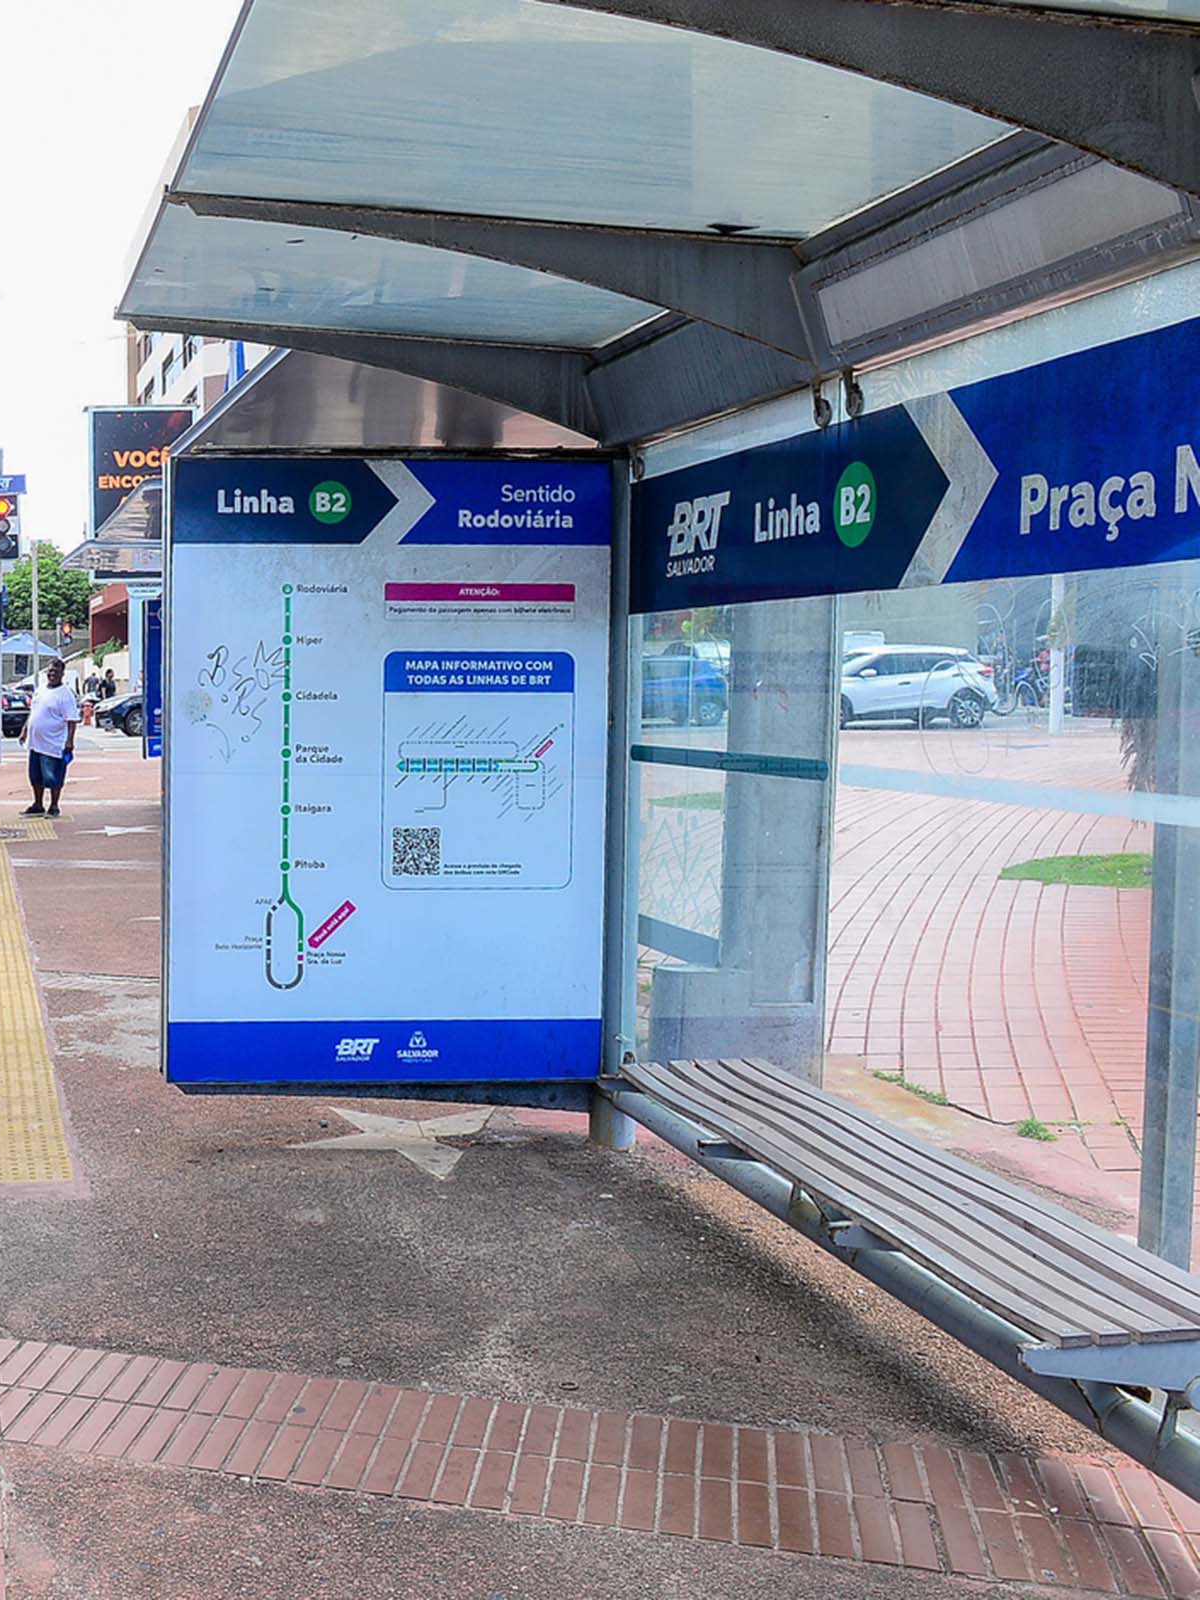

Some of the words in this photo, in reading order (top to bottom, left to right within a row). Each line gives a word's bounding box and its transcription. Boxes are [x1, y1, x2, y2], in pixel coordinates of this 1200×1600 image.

[500, 484, 576, 503] Sentido
[216, 489, 295, 514] Linha
[314, 491, 347, 513] B2
[1020, 471, 1156, 541] Praça
[754, 493, 821, 543] Linha
[840, 483, 871, 527] B2
[458, 509, 574, 529] Rodoviária
[667, 491, 731, 557] BRT
[666, 555, 716, 578] SALVADOR
[296, 583, 348, 594] Rodoviária
[296, 635, 323, 645] Hiper
[405, 660, 439, 670] MAPA
[441, 660, 523, 670] INFORMATIVO
[525, 660, 554, 670] COM
[407, 675, 447, 685] TODAS
[449, 675, 464, 685] AS
[466, 675, 509, 685] LINHAS
[511, 675, 527, 685] DE
[530, 675, 552, 685] BRT
[295, 691, 338, 701] Cidadela
[295, 744, 329, 755] Parque
[295, 754, 307, 763] da
[309, 754, 343, 763] Cidade
[294, 803, 332, 814] Itaigara
[294, 860, 325, 869] Pituba
[335, 1038, 380, 1056] BRT
